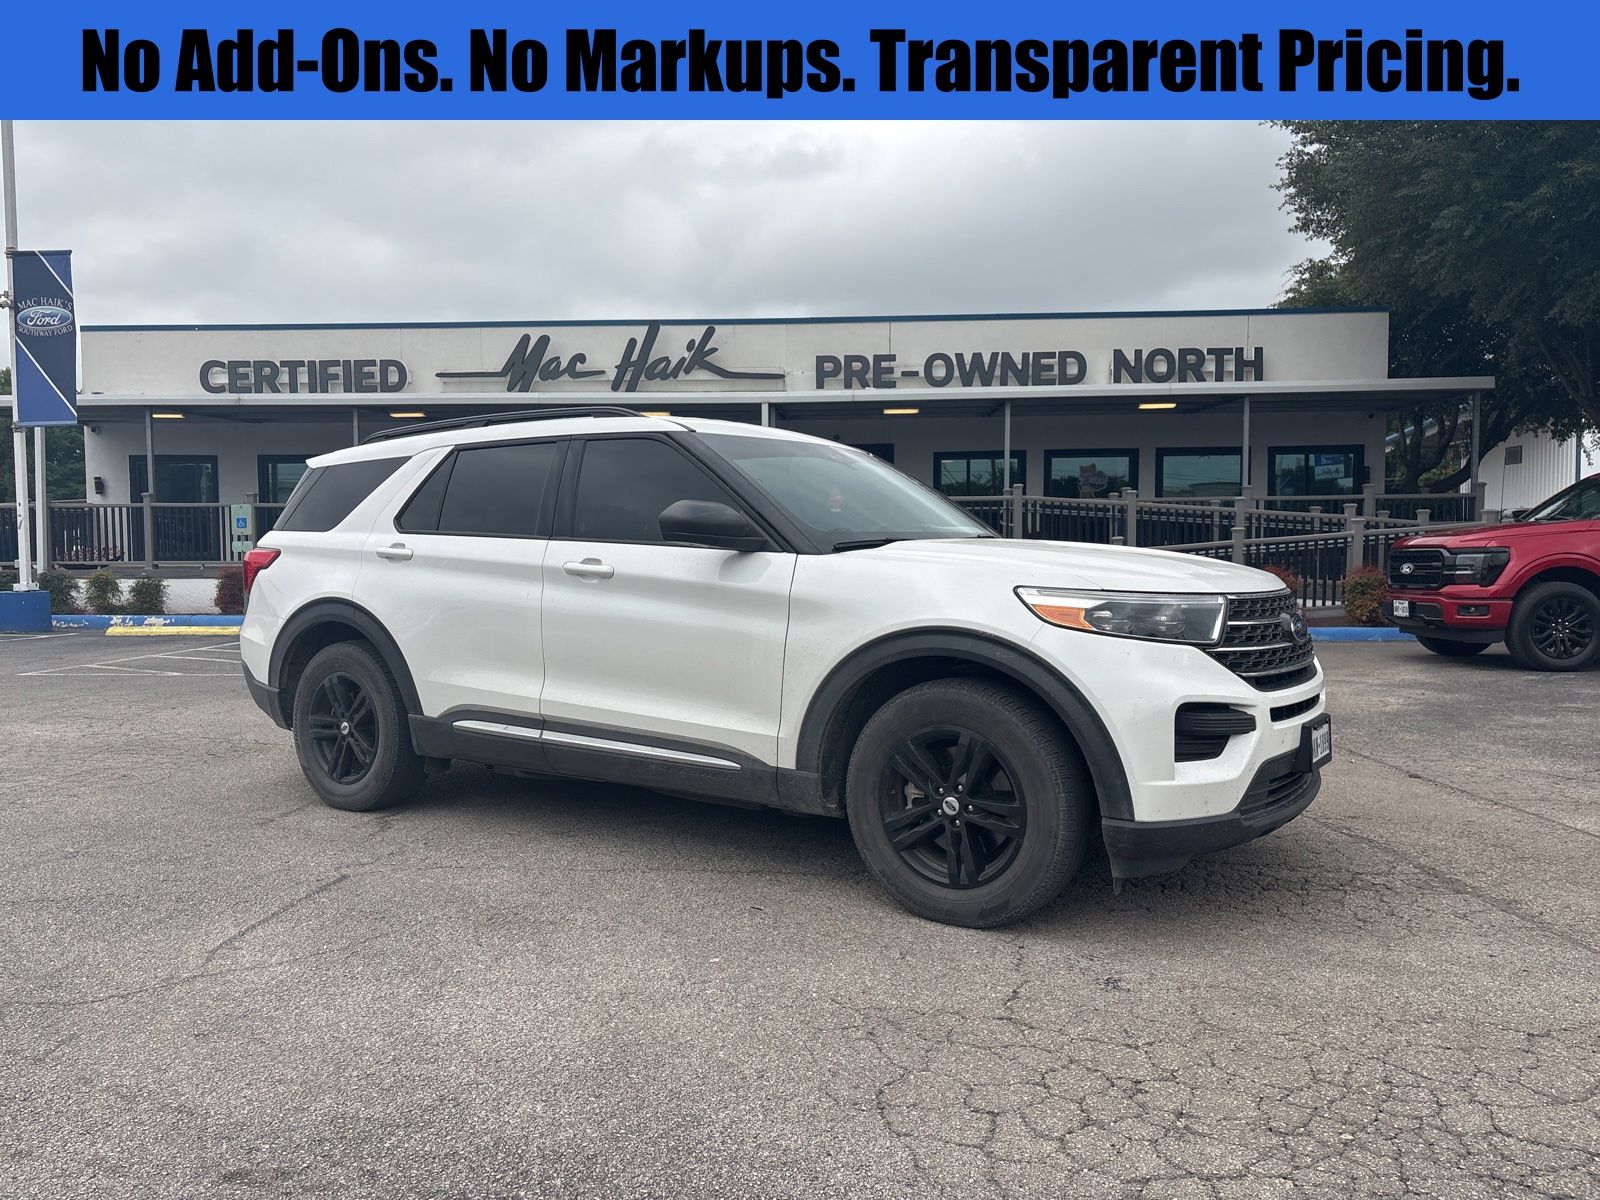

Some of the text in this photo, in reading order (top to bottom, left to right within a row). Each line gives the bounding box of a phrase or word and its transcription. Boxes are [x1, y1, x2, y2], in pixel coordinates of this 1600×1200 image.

[17, 296, 73, 311] MAC HAIK'S
[17, 324, 73, 337] SOUTHWAY FORD
[27, 310, 62, 326] Ford
[435, 319, 786, 393] Mac Haik
[815, 346, 1264, 390] PRE-OWNED NORTH
[199, 359, 408, 394] CERTIFIED
